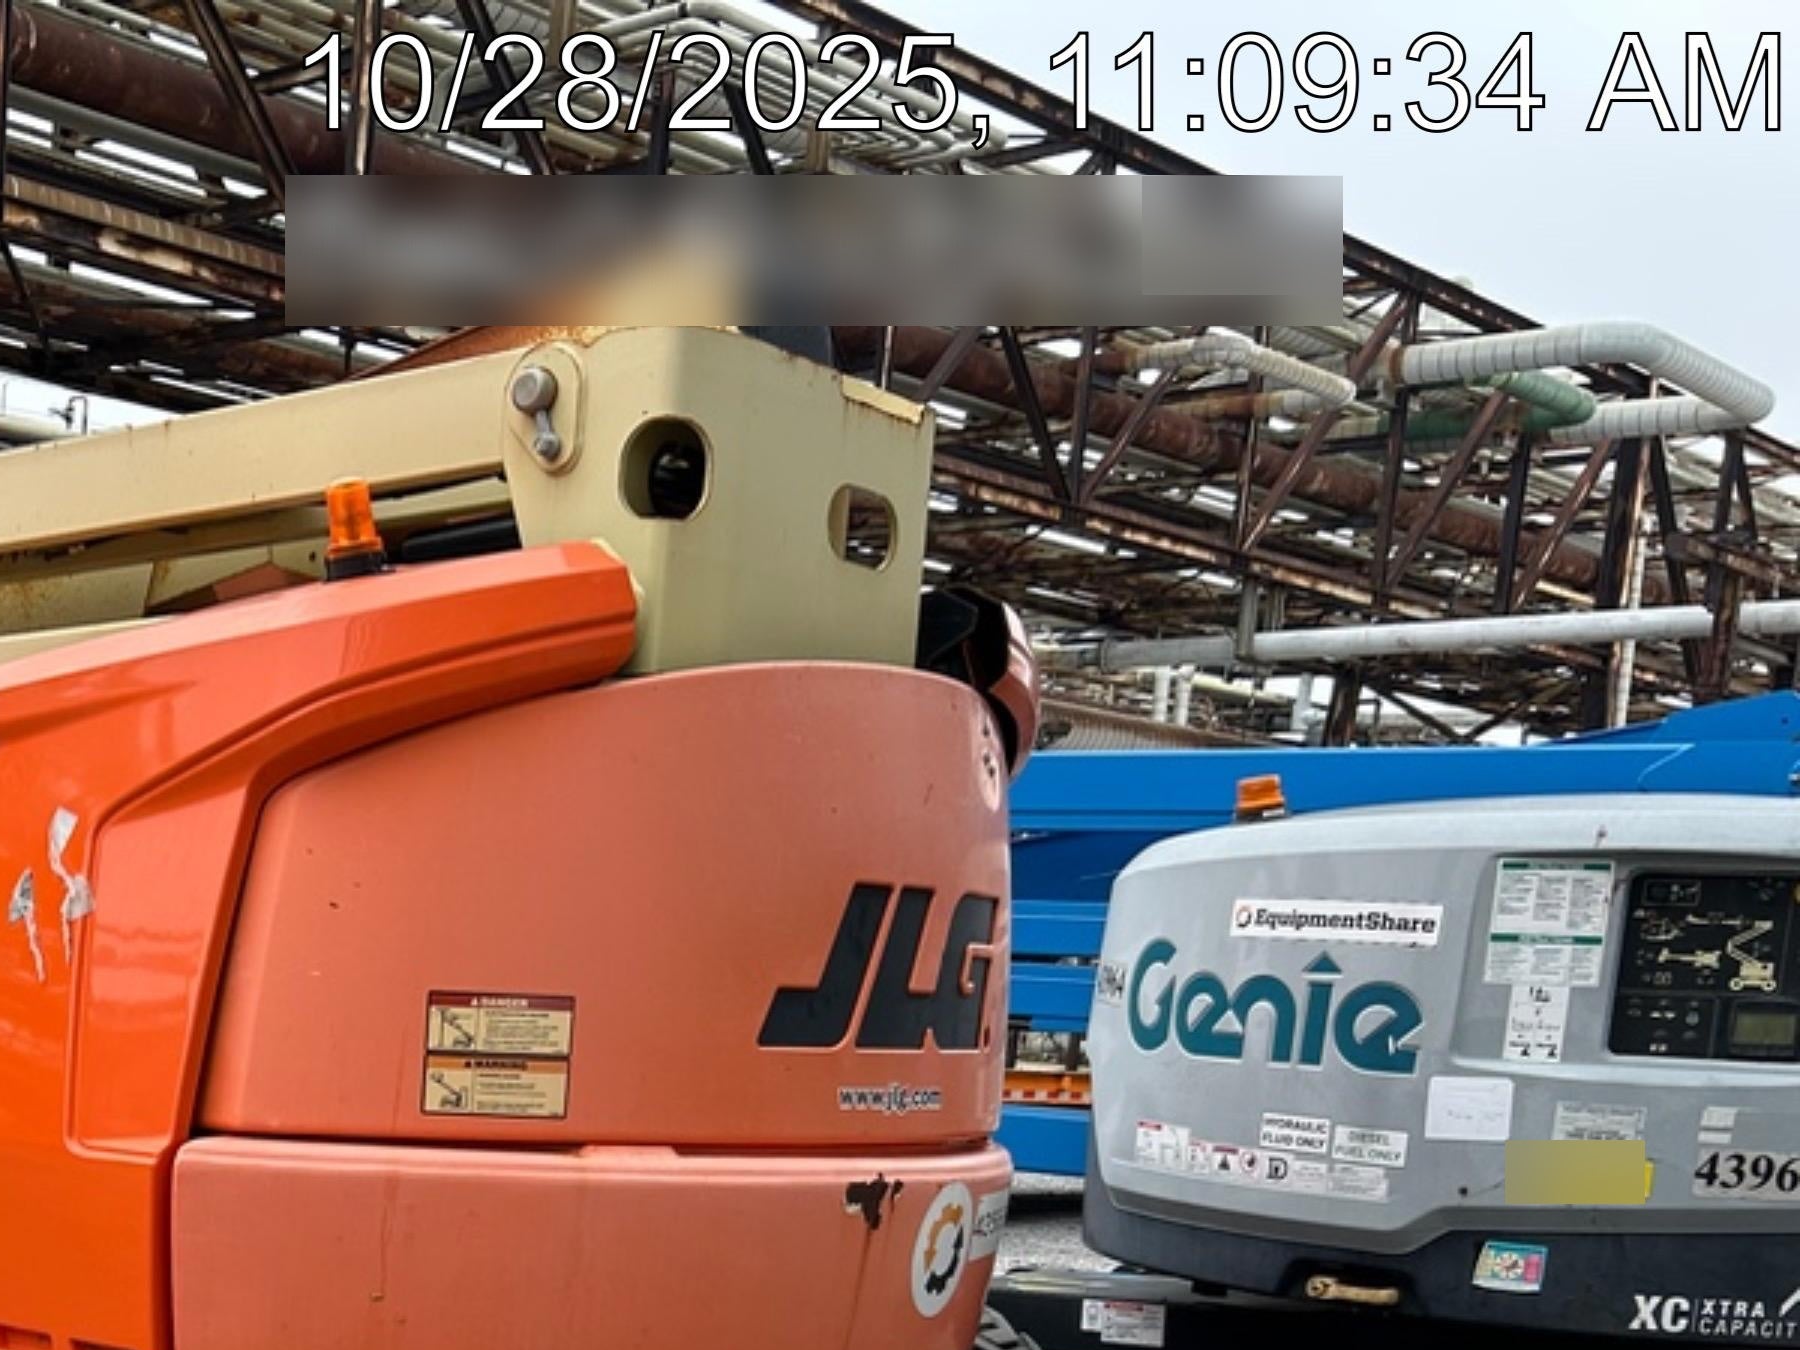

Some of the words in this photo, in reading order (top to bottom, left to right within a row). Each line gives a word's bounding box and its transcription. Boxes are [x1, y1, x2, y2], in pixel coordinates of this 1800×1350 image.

[1254, 908, 1436, 933] EquipmentShare
[757, 881, 1000, 1049] JLG
[1128, 938, 1424, 1075] Genie
[839, 1082, 941, 1113] www.jlg.com
[1265, 1117, 1327, 1134] HYDRAULIC
[1262, 1132, 1294, 1147] FLUID
[1295, 1136, 1325, 1149] ONLY
[1367, 1149, 1402, 1161] ONLY
[1628, 1294, 1691, 1334] XC
[1700, 1298, 1766, 1319] XTRA
